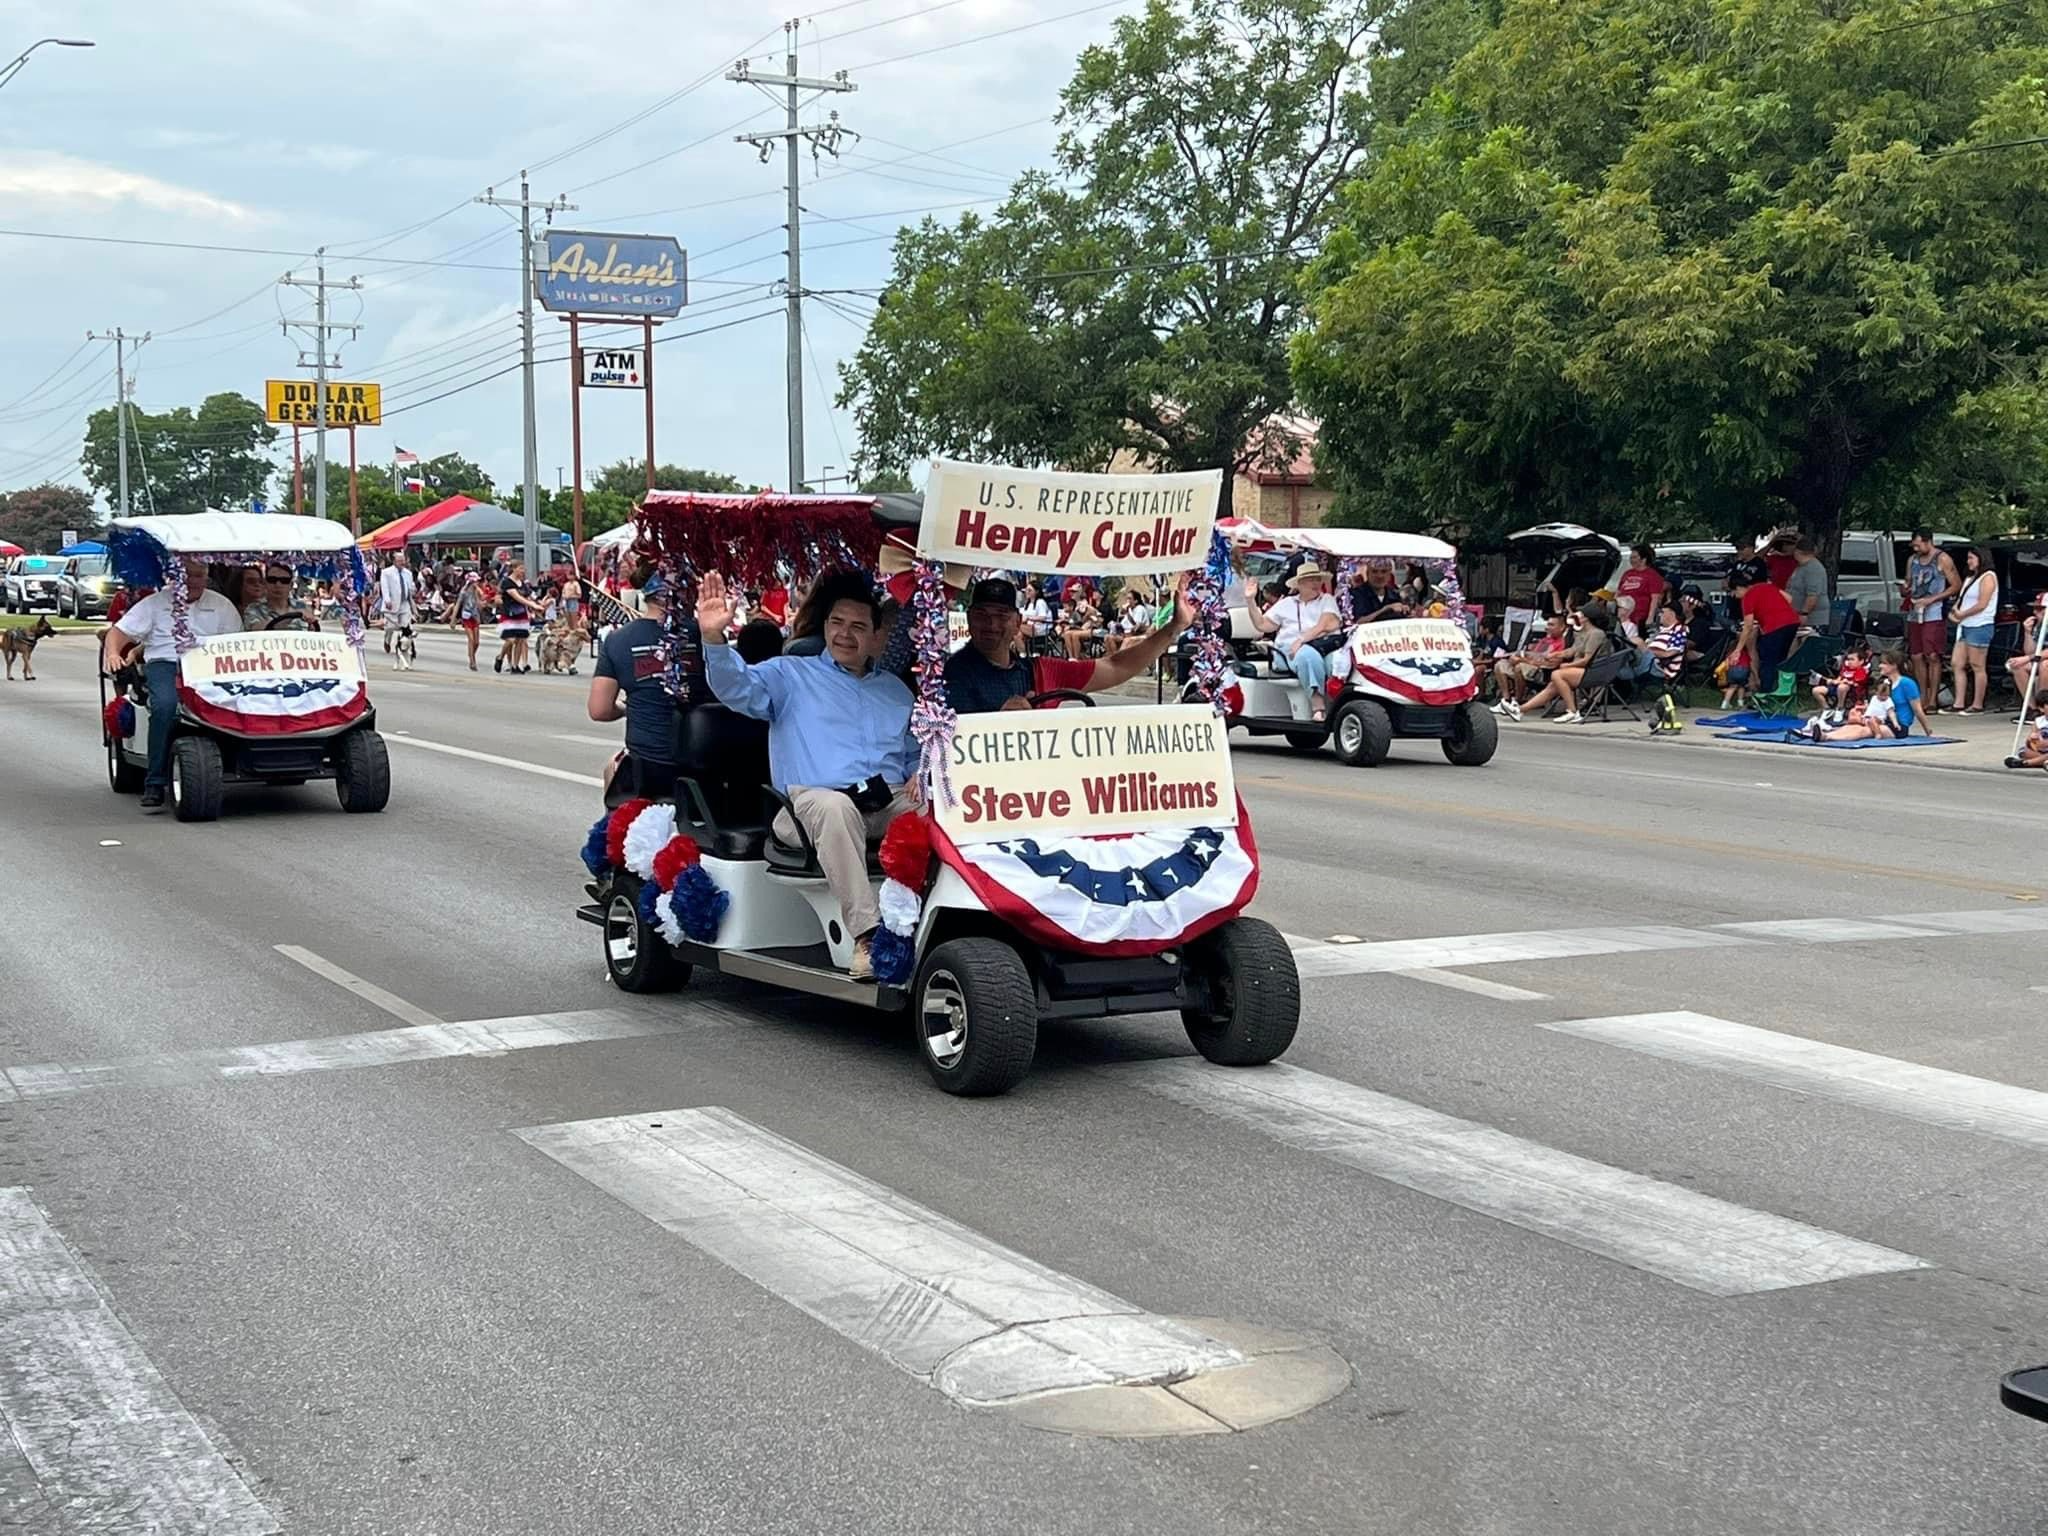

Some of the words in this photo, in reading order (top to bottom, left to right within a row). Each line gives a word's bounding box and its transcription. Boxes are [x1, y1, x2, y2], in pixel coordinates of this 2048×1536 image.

[548, 242, 677, 287] Arlan's
[594, 352, 634, 369] ATM
[590, 370, 625, 383] pulse
[980, 481, 1023, 510] U.S.
[1037, 488, 1194, 515] REPRESENTATIVE
[955, 509, 1080, 568] Henry
[1092, 517, 1197, 559] Cuellar
[201, 639, 256, 657] SCHERTZ
[262, 637, 289, 651] CITY
[294, 637, 344, 653] COUNCIL
[1361, 637, 1419, 656] Michelle
[1422, 637, 1466, 652] Watson
[214, 652, 274, 674] Mark
[279, 653, 339, 672] Davis
[952, 729, 1061, 765] SCHERTZ
[1071, 726, 1117, 758] CITY
[1126, 723, 1215, 755] MANAGER
[961, 785, 1071, 823] Steve
[1082, 771, 1218, 815] Williams
